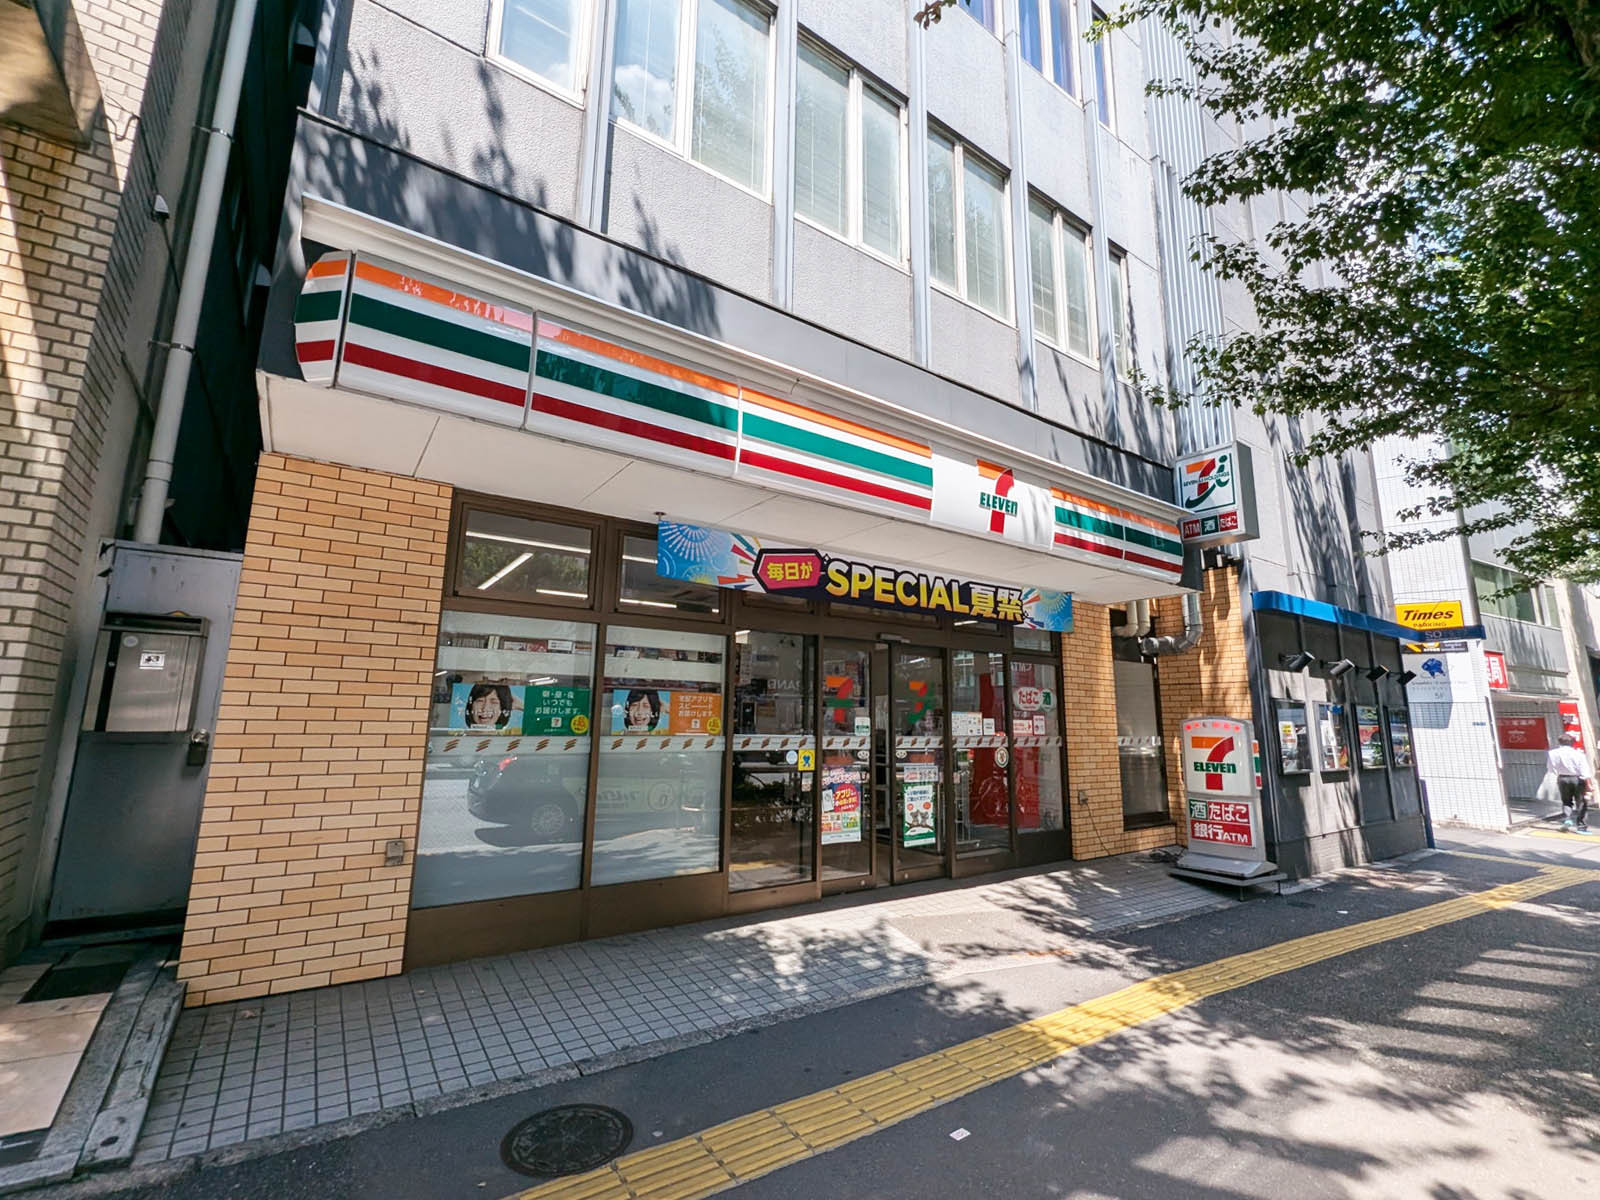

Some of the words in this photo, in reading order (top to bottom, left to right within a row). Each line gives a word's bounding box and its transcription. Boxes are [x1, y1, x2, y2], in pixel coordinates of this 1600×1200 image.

[1184, 521, 1200, 537] ATM
[767, 562, 813, 581] 毎日が
[1403, 609, 1454, 621] Times
[1191, 801, 1208, 819] 酒
[1209, 803, 1249, 823] たばこ
